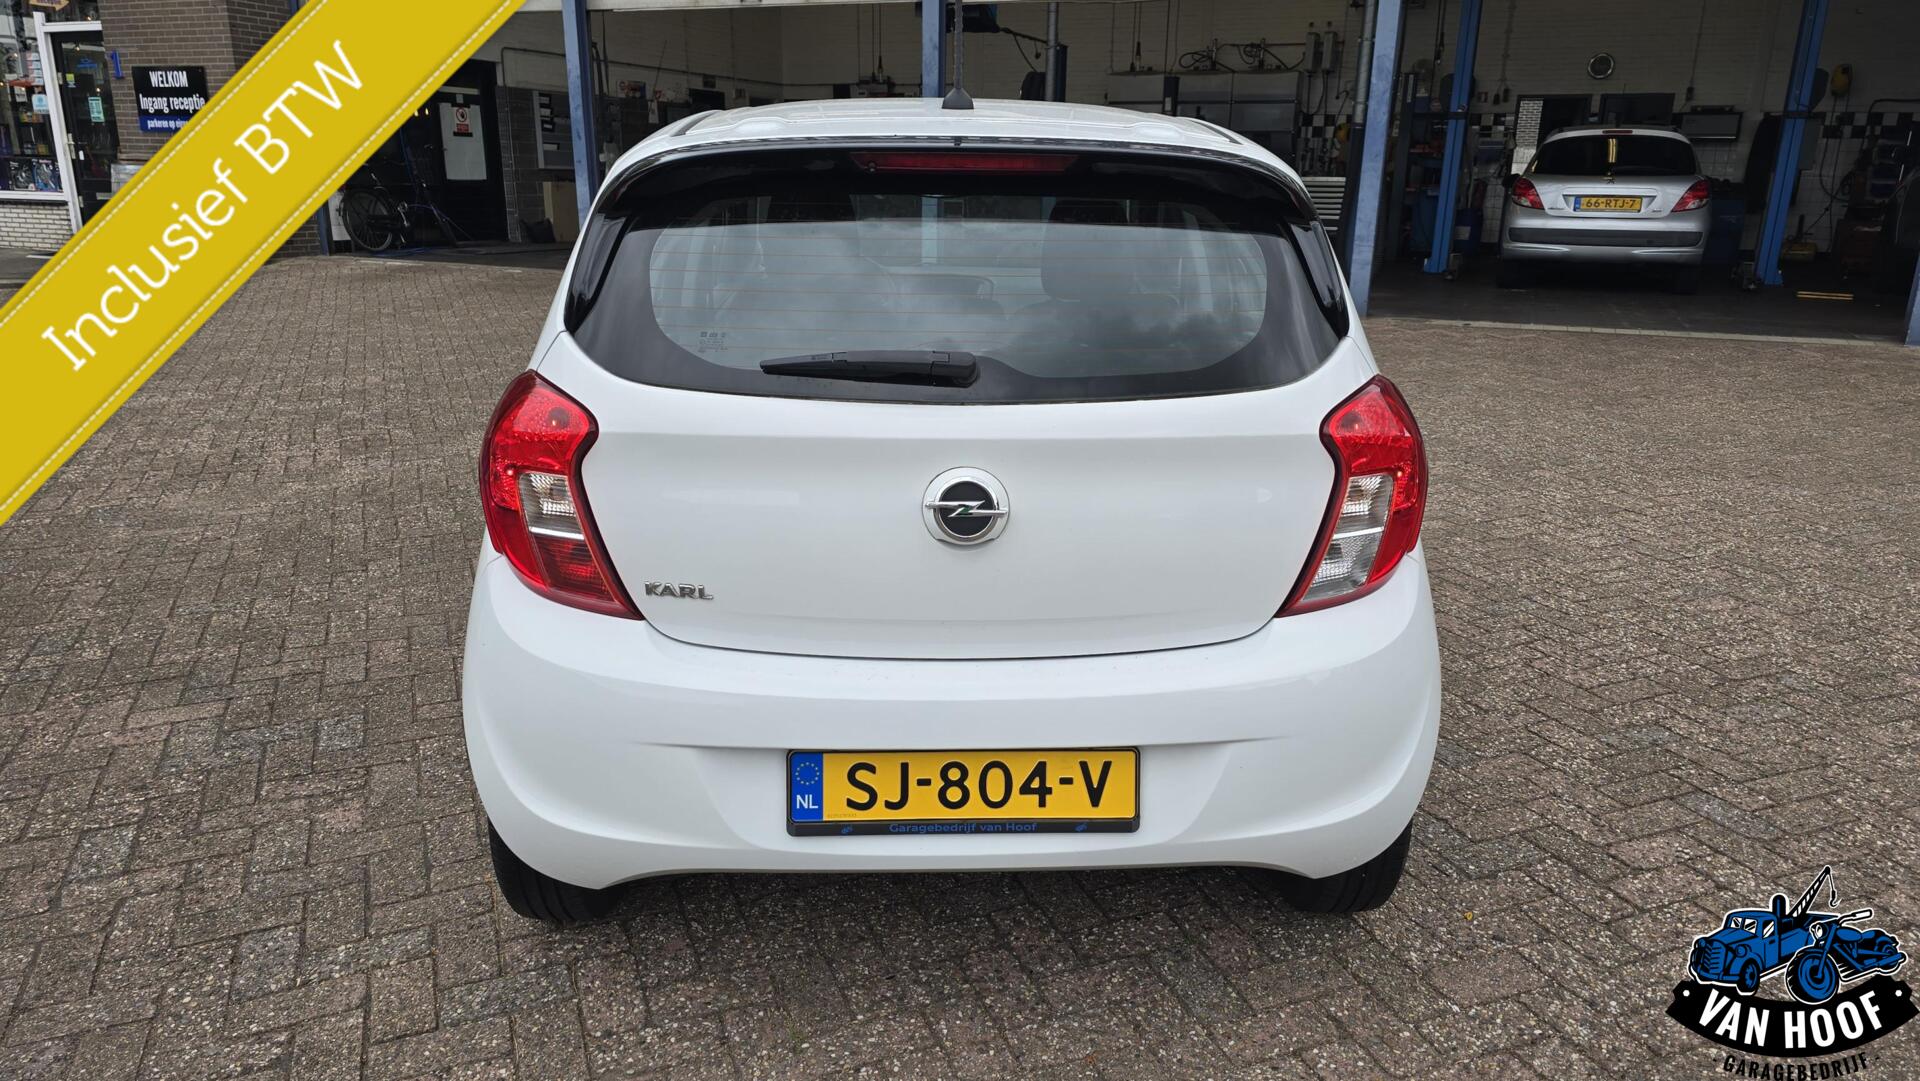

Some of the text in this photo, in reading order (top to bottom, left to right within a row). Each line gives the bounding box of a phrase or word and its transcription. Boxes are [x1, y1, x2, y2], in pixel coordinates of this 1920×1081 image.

[149, 70, 188, 87] WELKOM
[139, 93, 205, 114] Ingang receptie
[1586, 199, 1637, 209] 66-RTJ-7
[644, 581, 714, 600] KARL
[846, 760, 1113, 811] SJ-804-V
[796, 794, 819, 809] NL
[889, 822, 1038, 834] Garagebedrijf van Hoof
